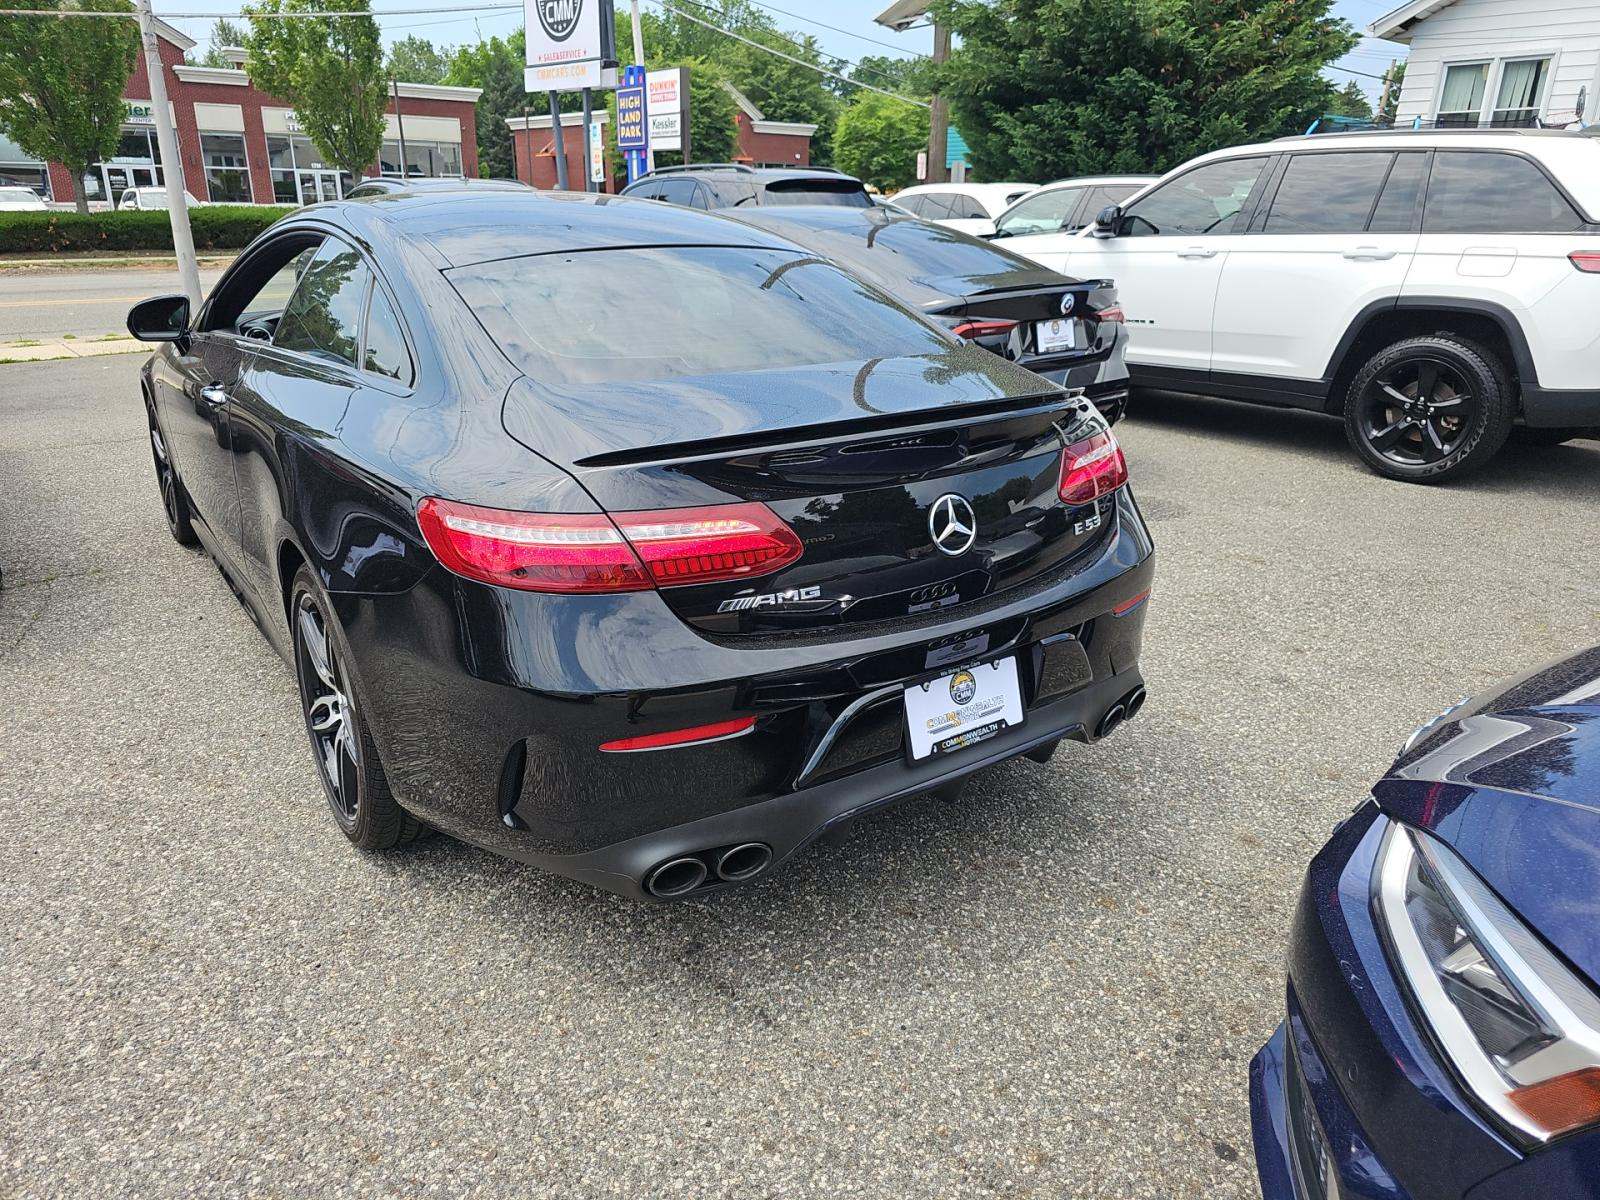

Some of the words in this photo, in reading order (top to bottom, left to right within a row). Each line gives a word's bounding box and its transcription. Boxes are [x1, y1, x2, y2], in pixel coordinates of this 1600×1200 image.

[545, 0, 574, 23] CMM
[620, 96, 640, 109] HIGH
[620, 111, 641, 124] LAND
[620, 126, 641, 138] PARK
[1074, 522, 1083, 536] E
[752, 585, 821, 609] AMG
[941, 723, 998, 748] COMMONWEALTH
